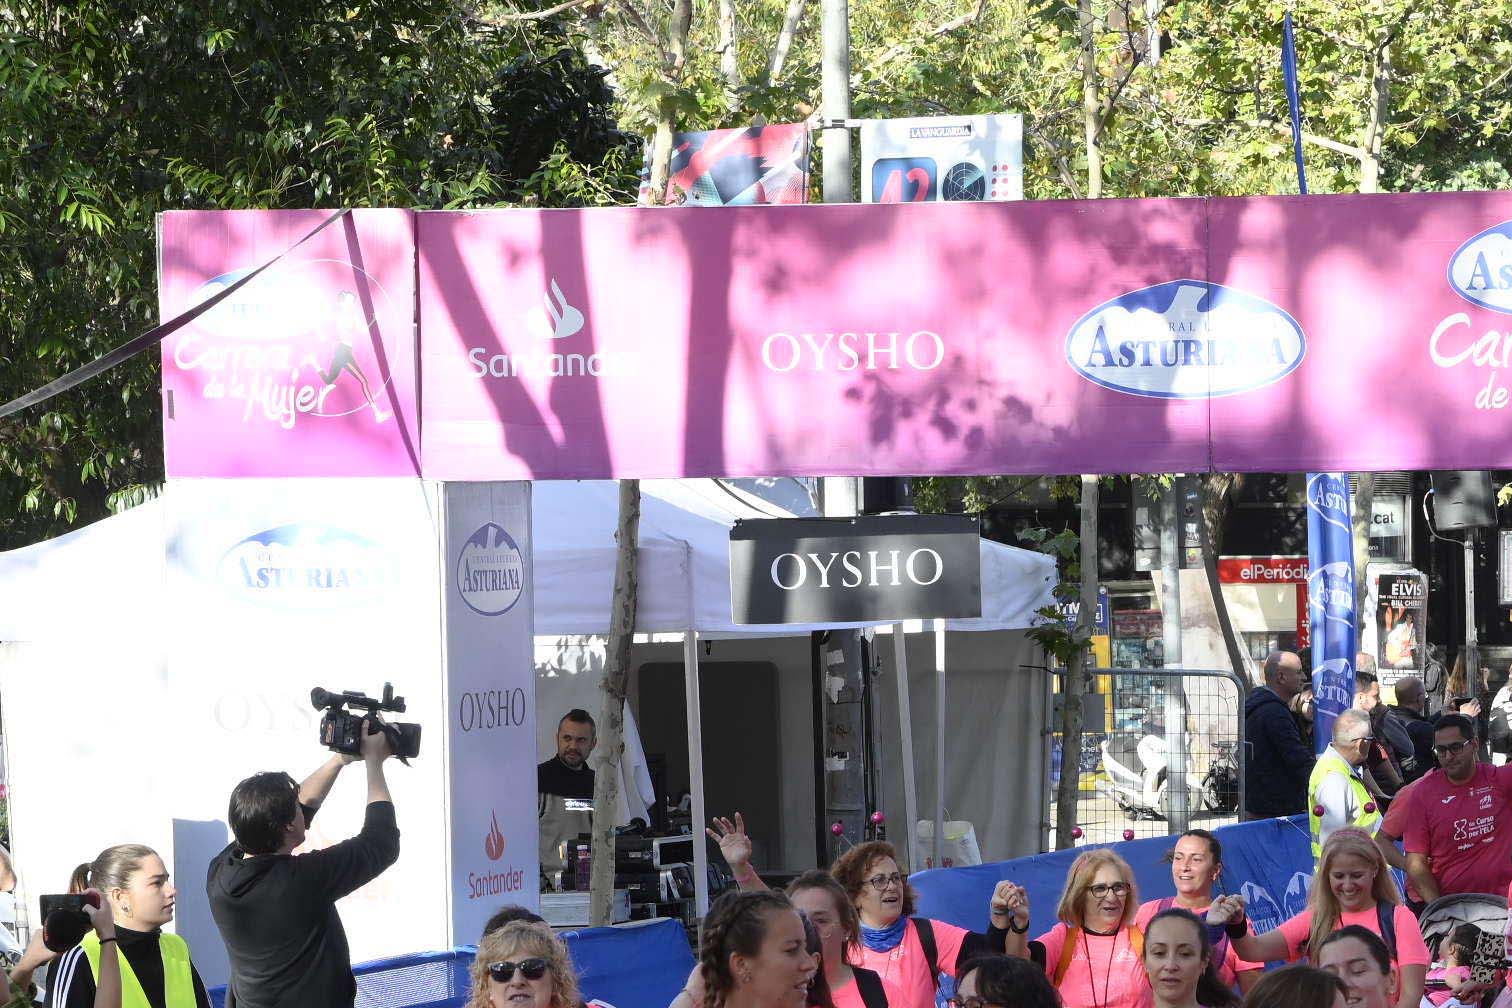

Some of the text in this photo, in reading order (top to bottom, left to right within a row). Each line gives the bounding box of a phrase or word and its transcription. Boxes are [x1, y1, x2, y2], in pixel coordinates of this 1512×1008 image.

[761, 330, 946, 373] OYSHO
[1084, 320, 1289, 369] ASTURIANA
[1475, 371, 1509, 411] de
[462, 561, 520, 593] ASTURIANA
[770, 548, 943, 591] OYSHO
[1391, 583, 1422, 596] ELVIS
[459, 687, 526, 732] OYSHO
[468, 868, 525, 901] Santander
